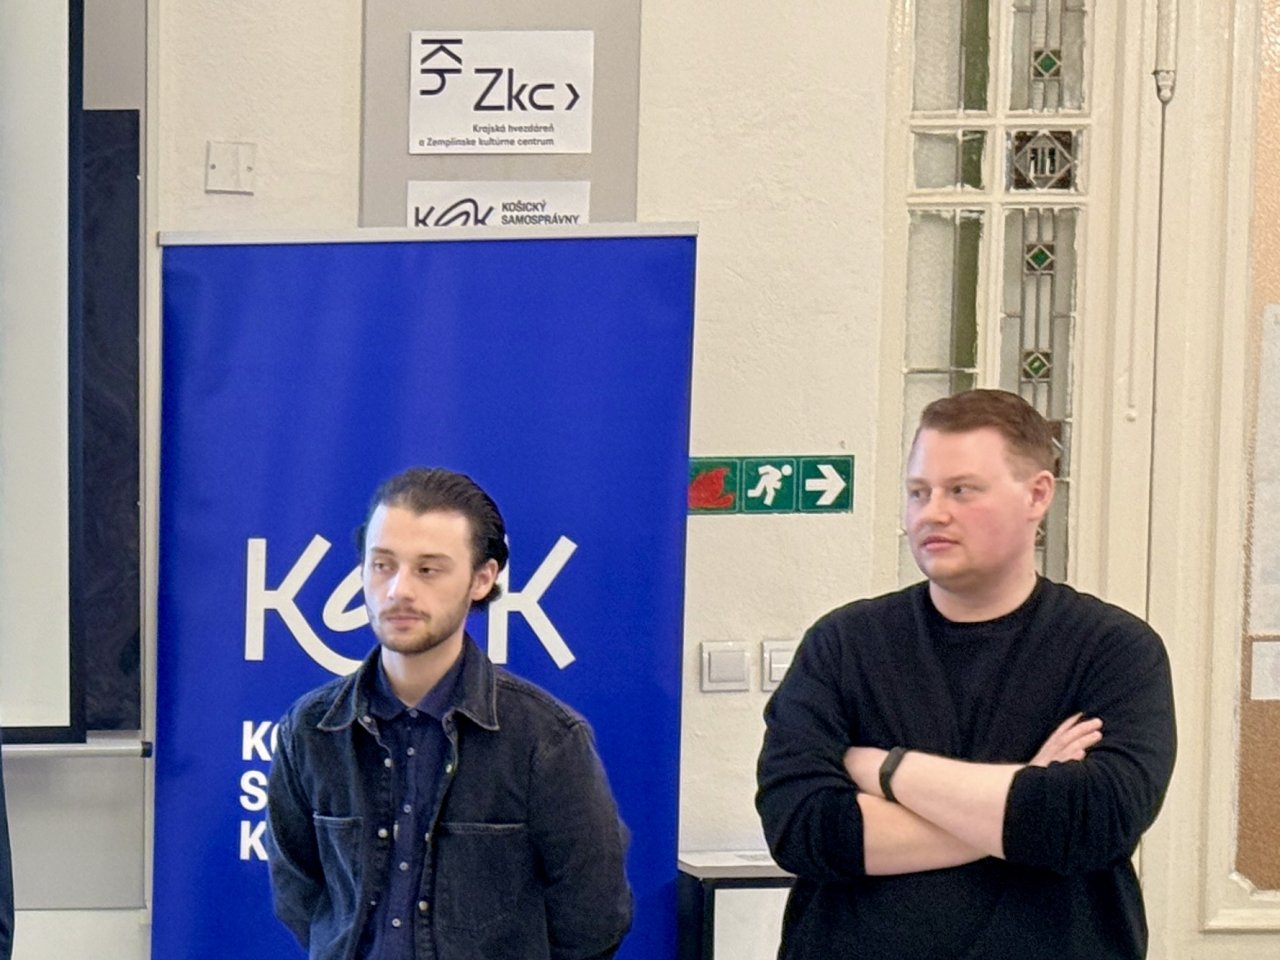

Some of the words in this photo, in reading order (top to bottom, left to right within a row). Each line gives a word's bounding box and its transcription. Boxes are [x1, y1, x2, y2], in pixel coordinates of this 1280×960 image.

[472, 124, 506, 135] Krajská
[508, 123, 554, 133] hvezdáreň
[426, 137, 476, 148] Zemplínske
[478, 137, 515, 146] kultúrne
[517, 138, 555, 146] centrum
[501, 200, 547, 212] KOŠICKÝ
[501, 213, 580, 226] SAMOSPRÁVNY
